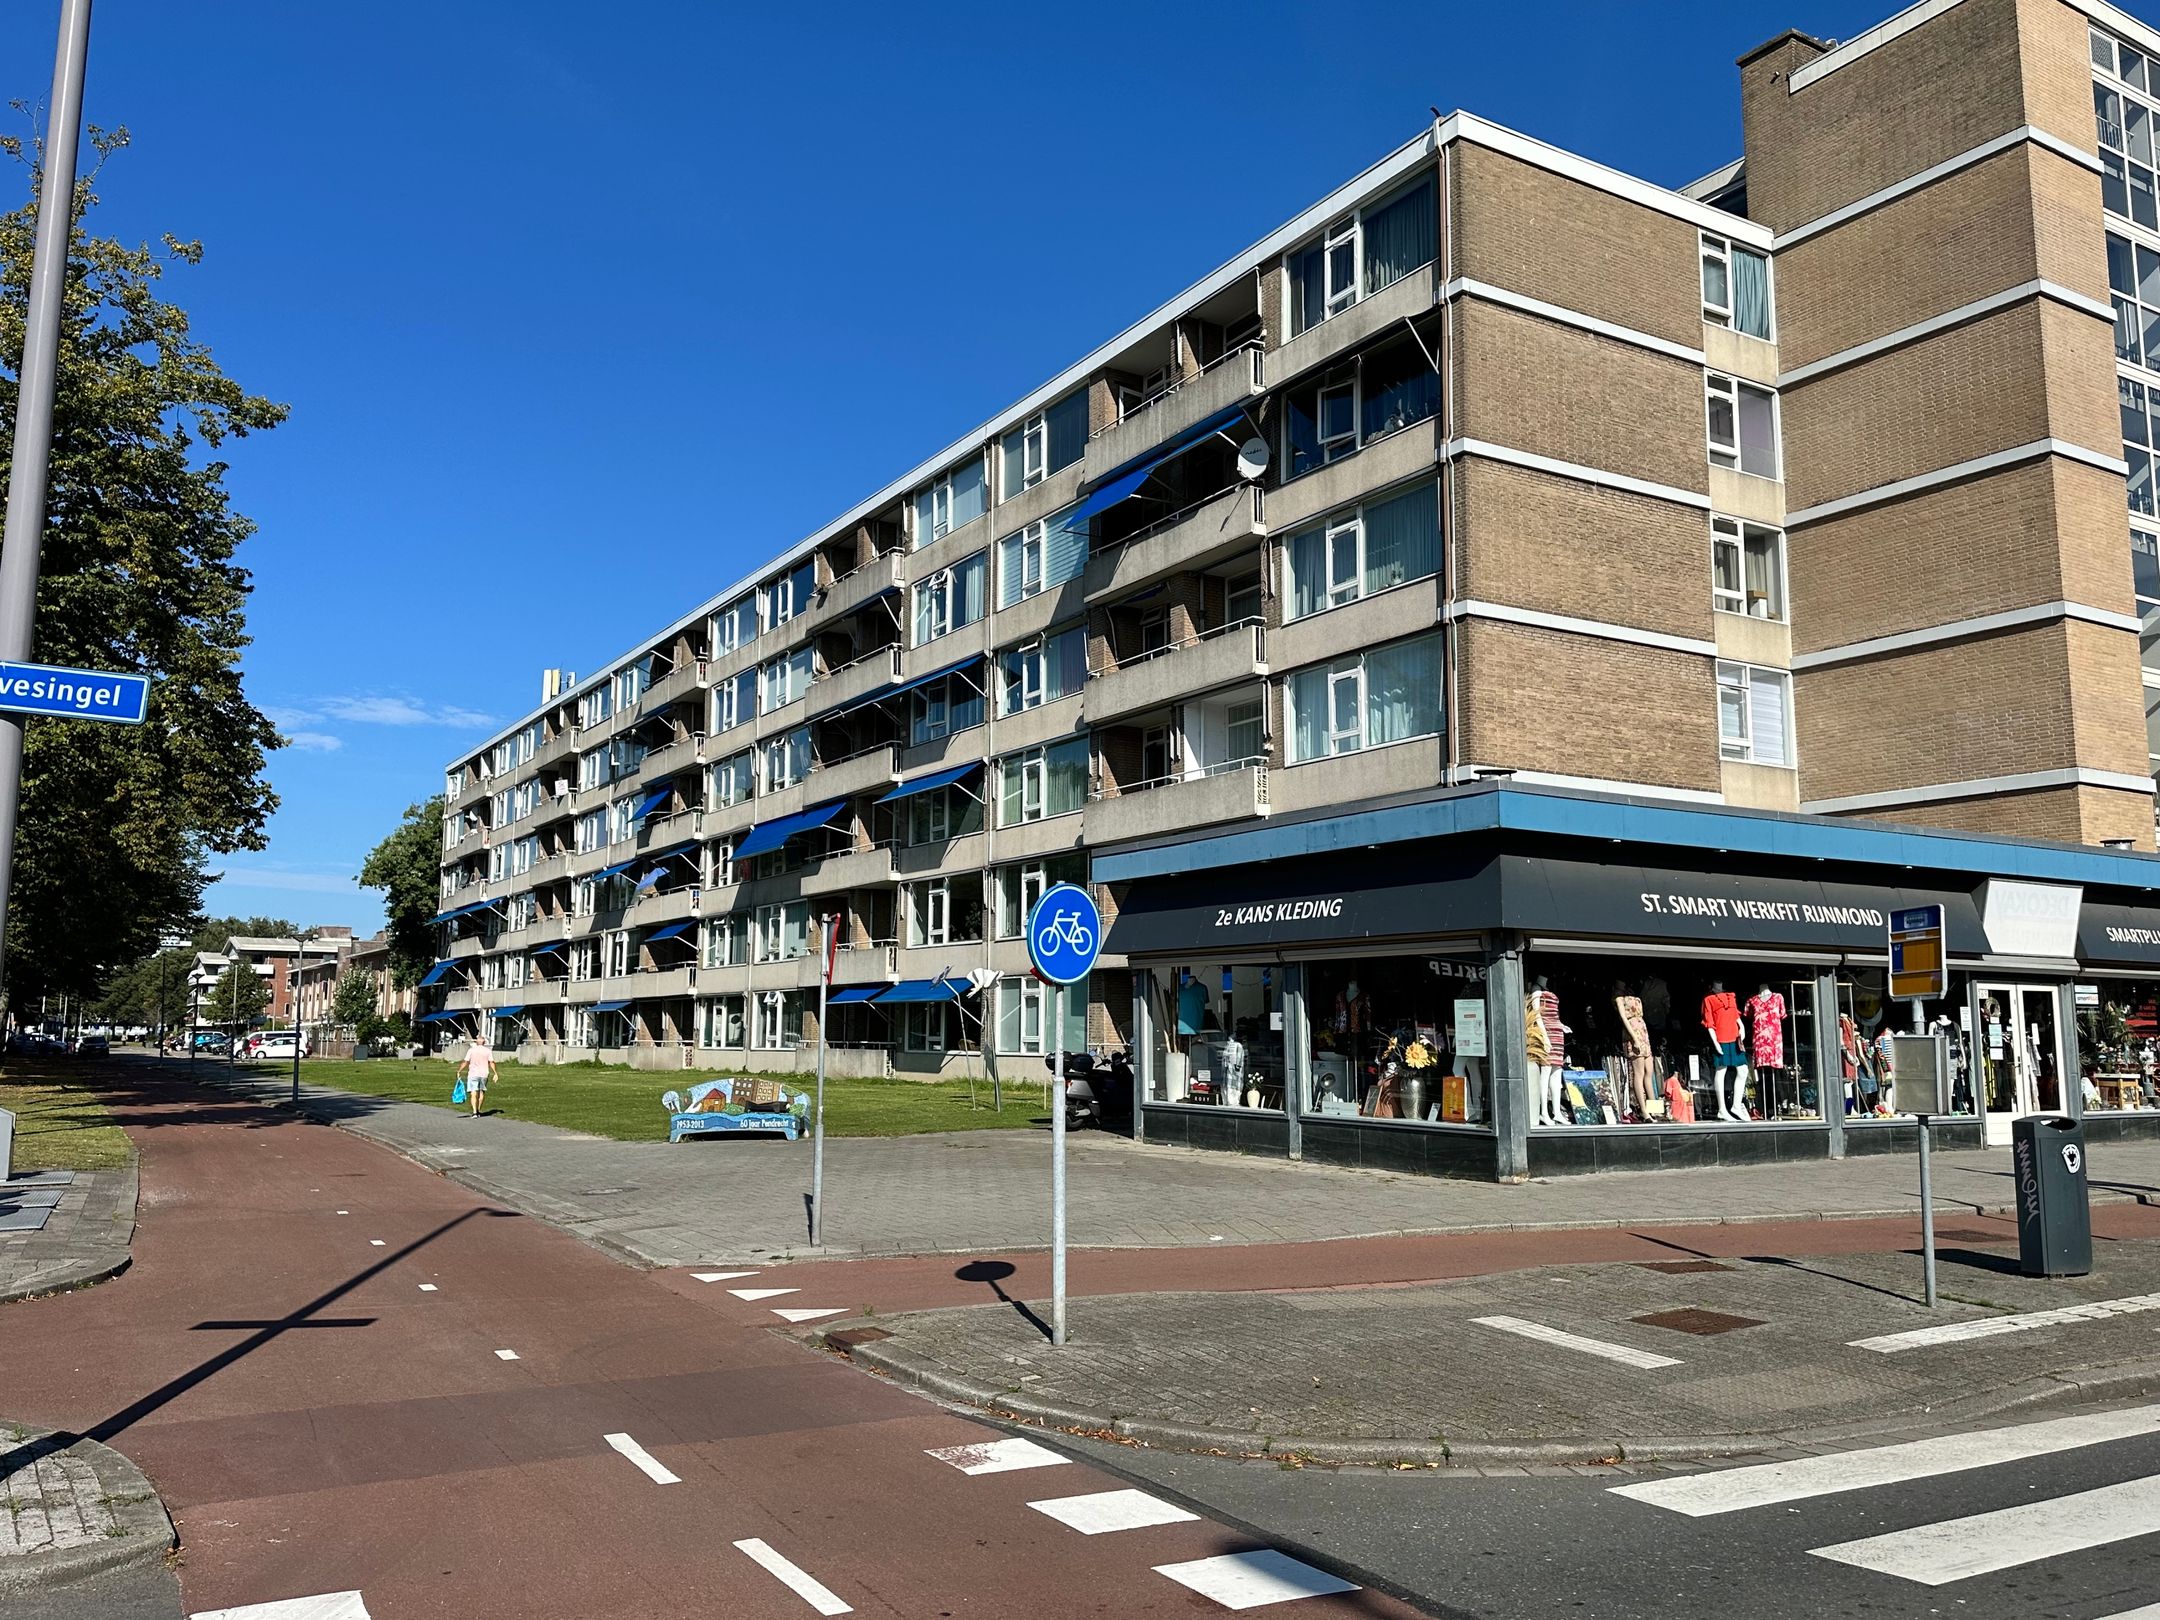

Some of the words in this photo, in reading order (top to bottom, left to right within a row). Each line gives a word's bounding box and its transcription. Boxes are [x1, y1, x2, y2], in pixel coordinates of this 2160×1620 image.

[0, 677, 121, 708] vesingel
[1215, 909, 1233, 927] 2e
[1235, 904, 1274, 925] KANS
[1276, 898, 1343, 921] KLEDING
[1640, 893, 1667, 913] ST.
[1668, 895, 1729, 918] SMART
[1730, 899, 1800, 922] WERKFIT
[1802, 904, 1884, 927] RIJNMOND
[740, 1118, 748, 1128] 60
